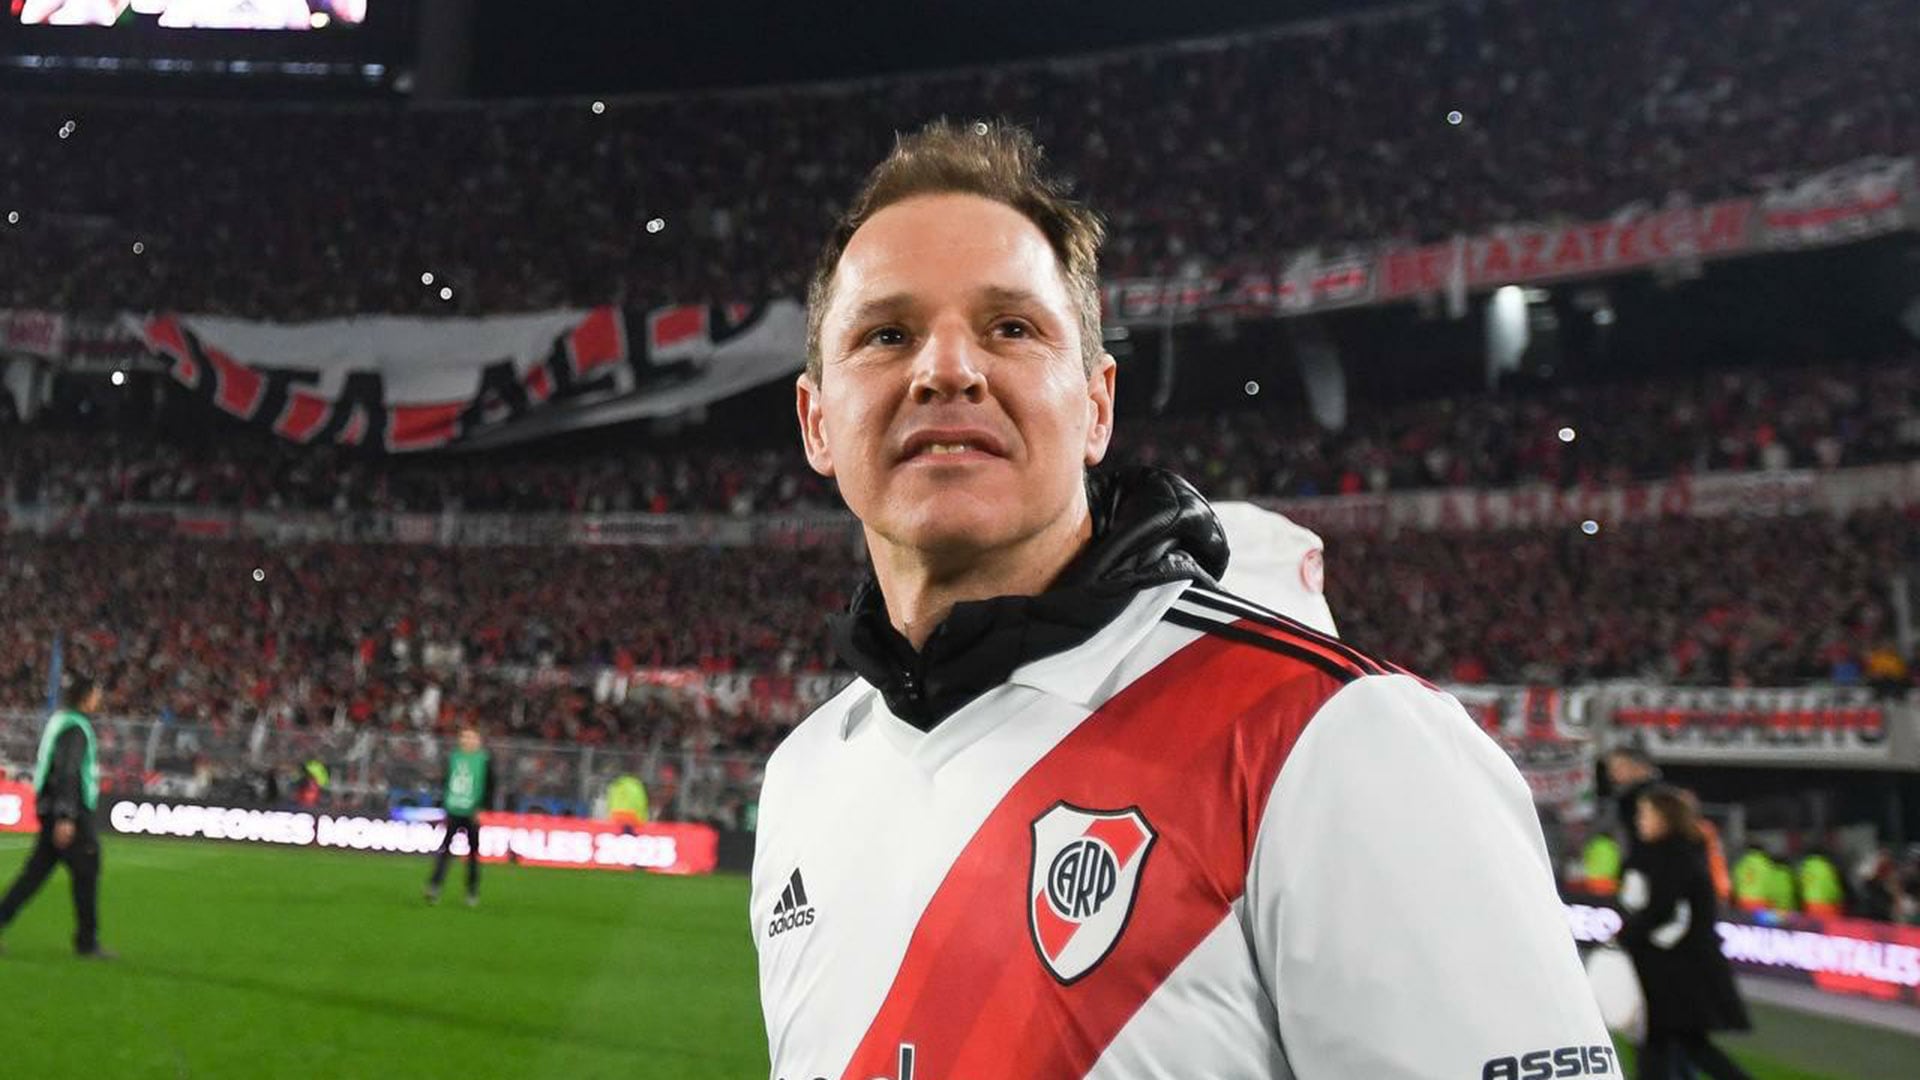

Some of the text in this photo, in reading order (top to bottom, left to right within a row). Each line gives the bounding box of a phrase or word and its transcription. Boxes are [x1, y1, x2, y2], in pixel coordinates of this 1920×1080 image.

[111, 800, 676, 867] CAMPEONES MONUMTALES 2023
[1048, 840, 1116, 919] CARP
[768, 907, 815, 938] adidas
[1482, 1046, 1615, 1080] ASSIST
